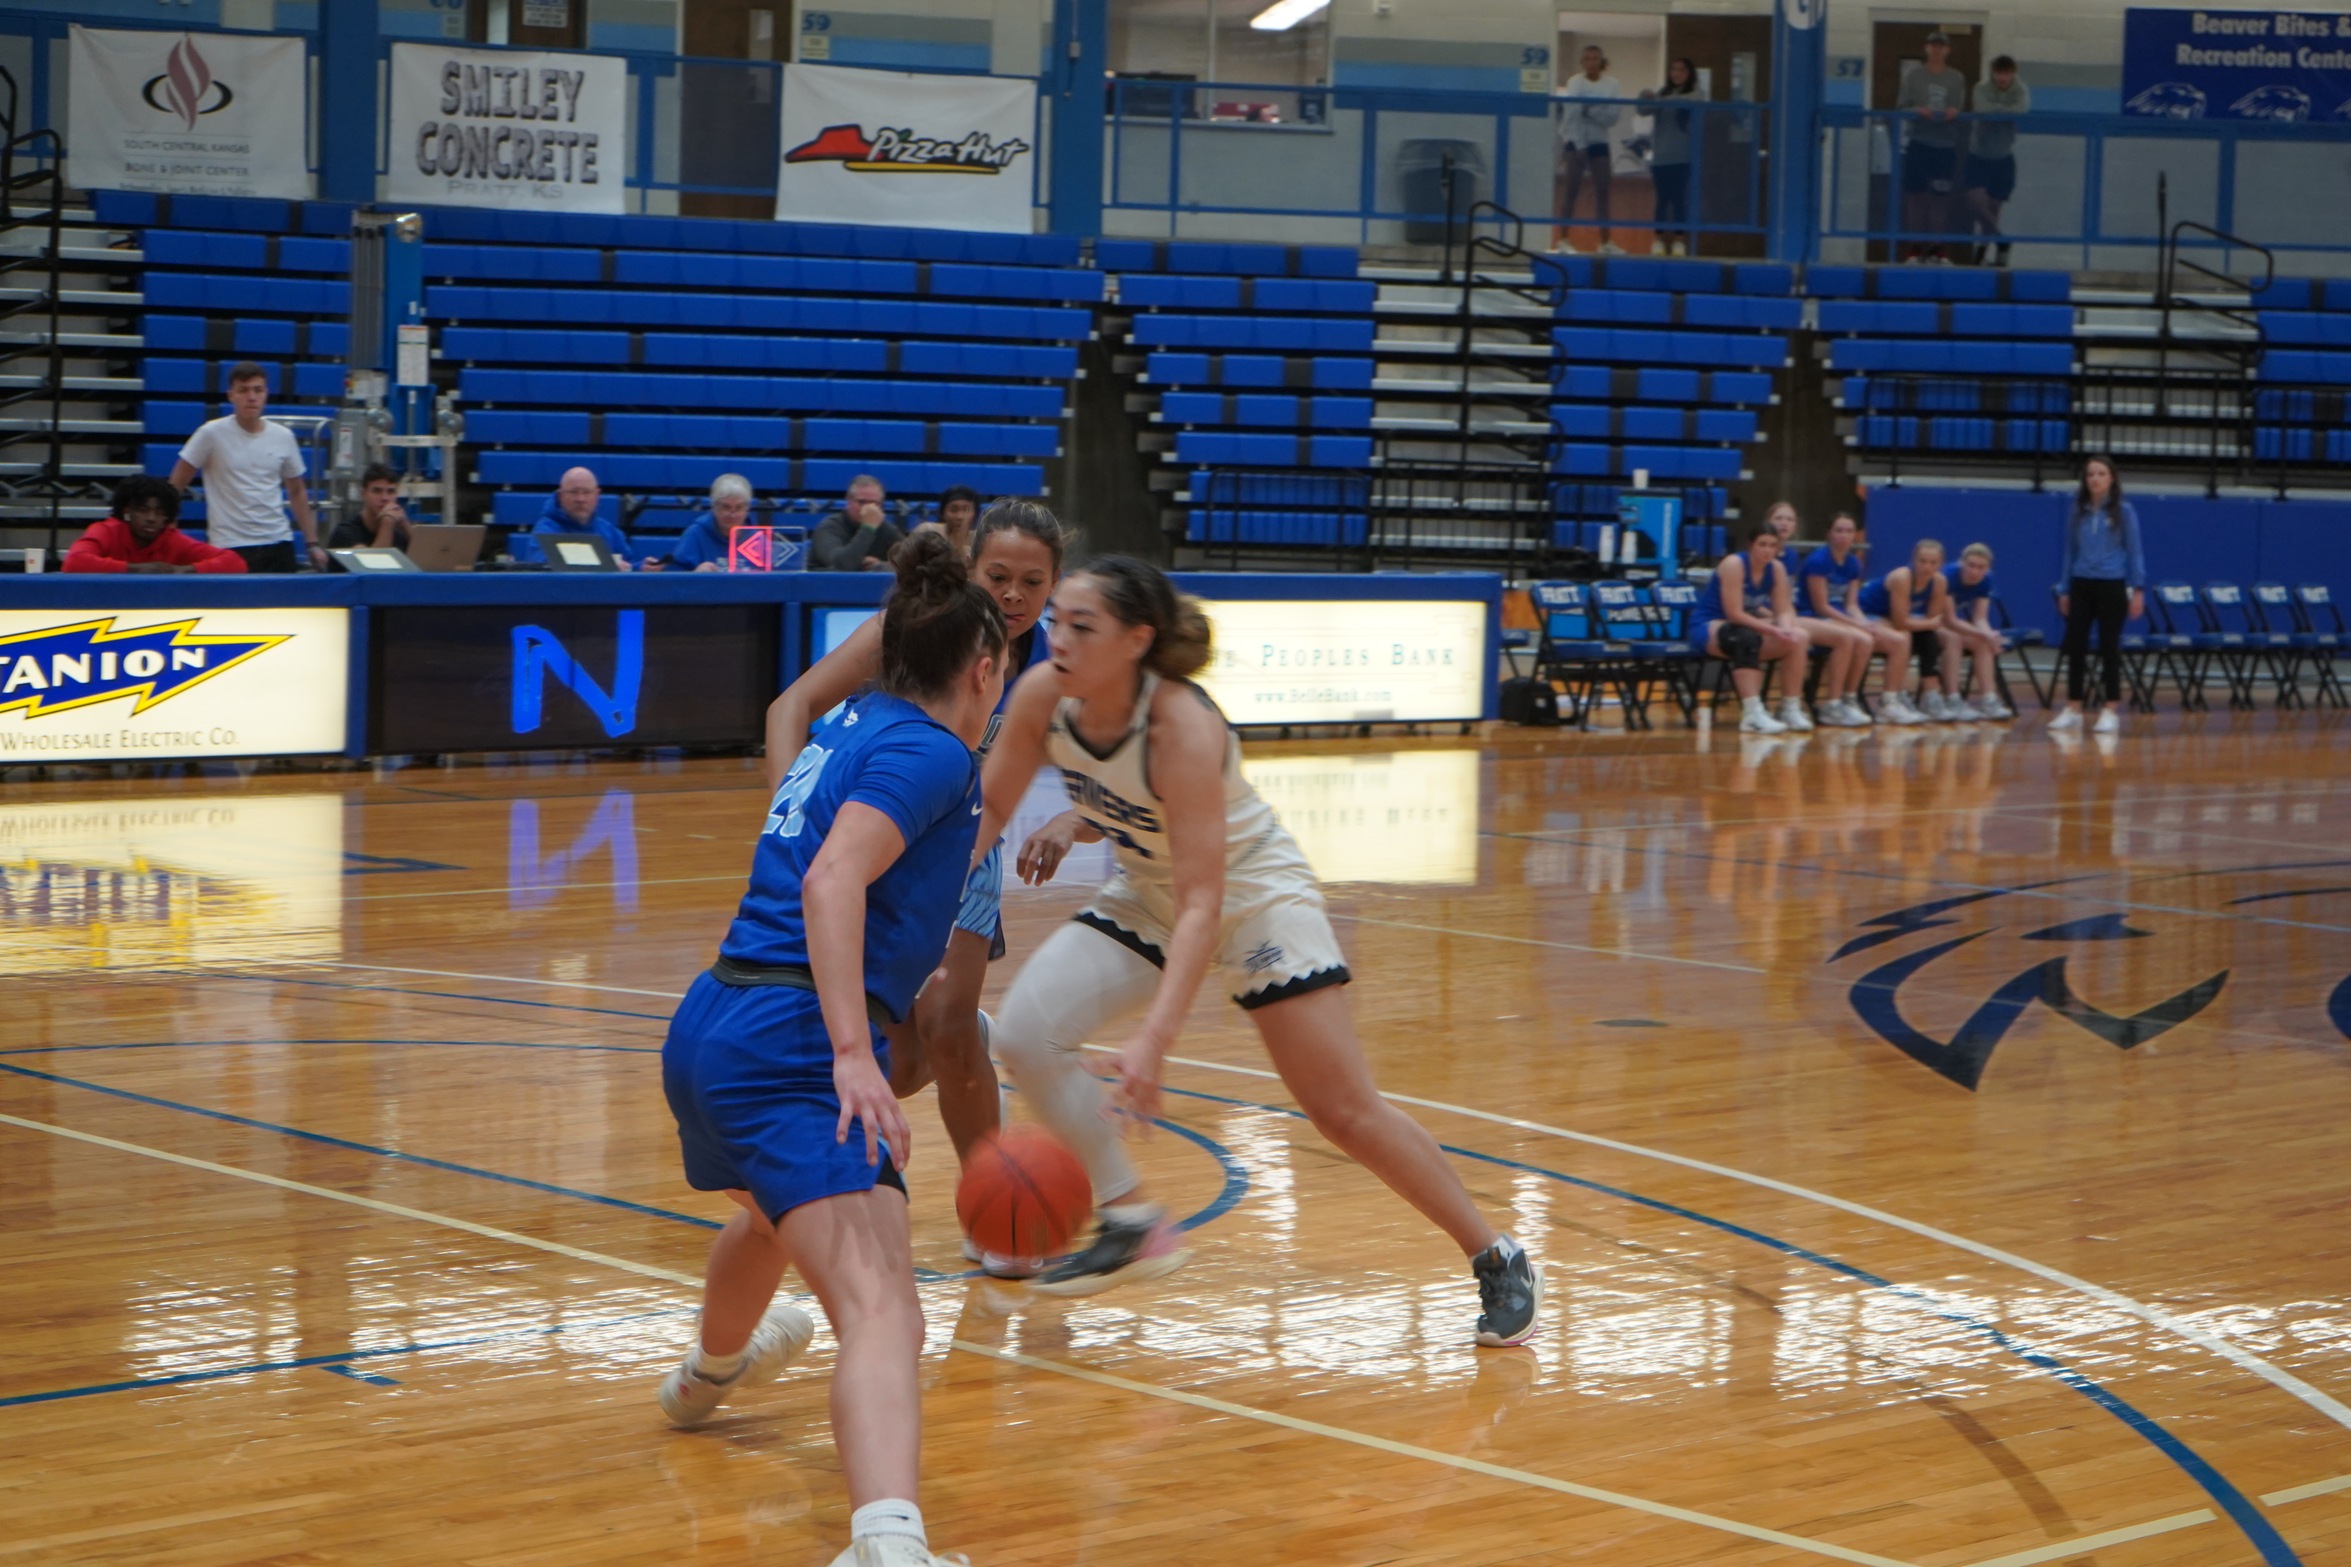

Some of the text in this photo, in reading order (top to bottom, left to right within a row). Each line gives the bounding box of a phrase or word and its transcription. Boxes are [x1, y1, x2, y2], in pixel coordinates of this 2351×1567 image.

[2192, 12, 2269, 35] Beaver
[2274, 14, 2330, 37] Bites
[2176, 43, 2293, 68] Recreation
[440, 61, 585, 122] SMILEY
[162, 141, 208, 152] CENTRAL
[211, 144, 250, 154] KANSAS
[415, 121, 599, 184] CONCRETE
[867, 127, 1030, 167] Pizza Hut
[125, 162, 249, 177] BONE & JOINT CENTER
[532, 185, 563, 199] KS
[1261, 644, 1369, 667] PEOPLES
[1391, 643, 1454, 665] BANK
[0, 647, 206, 693] ANION
[511, 610, 645, 738] N
[1, 732, 112, 750] WHOLESALE
[120, 729, 203, 748] ELECTRIC
